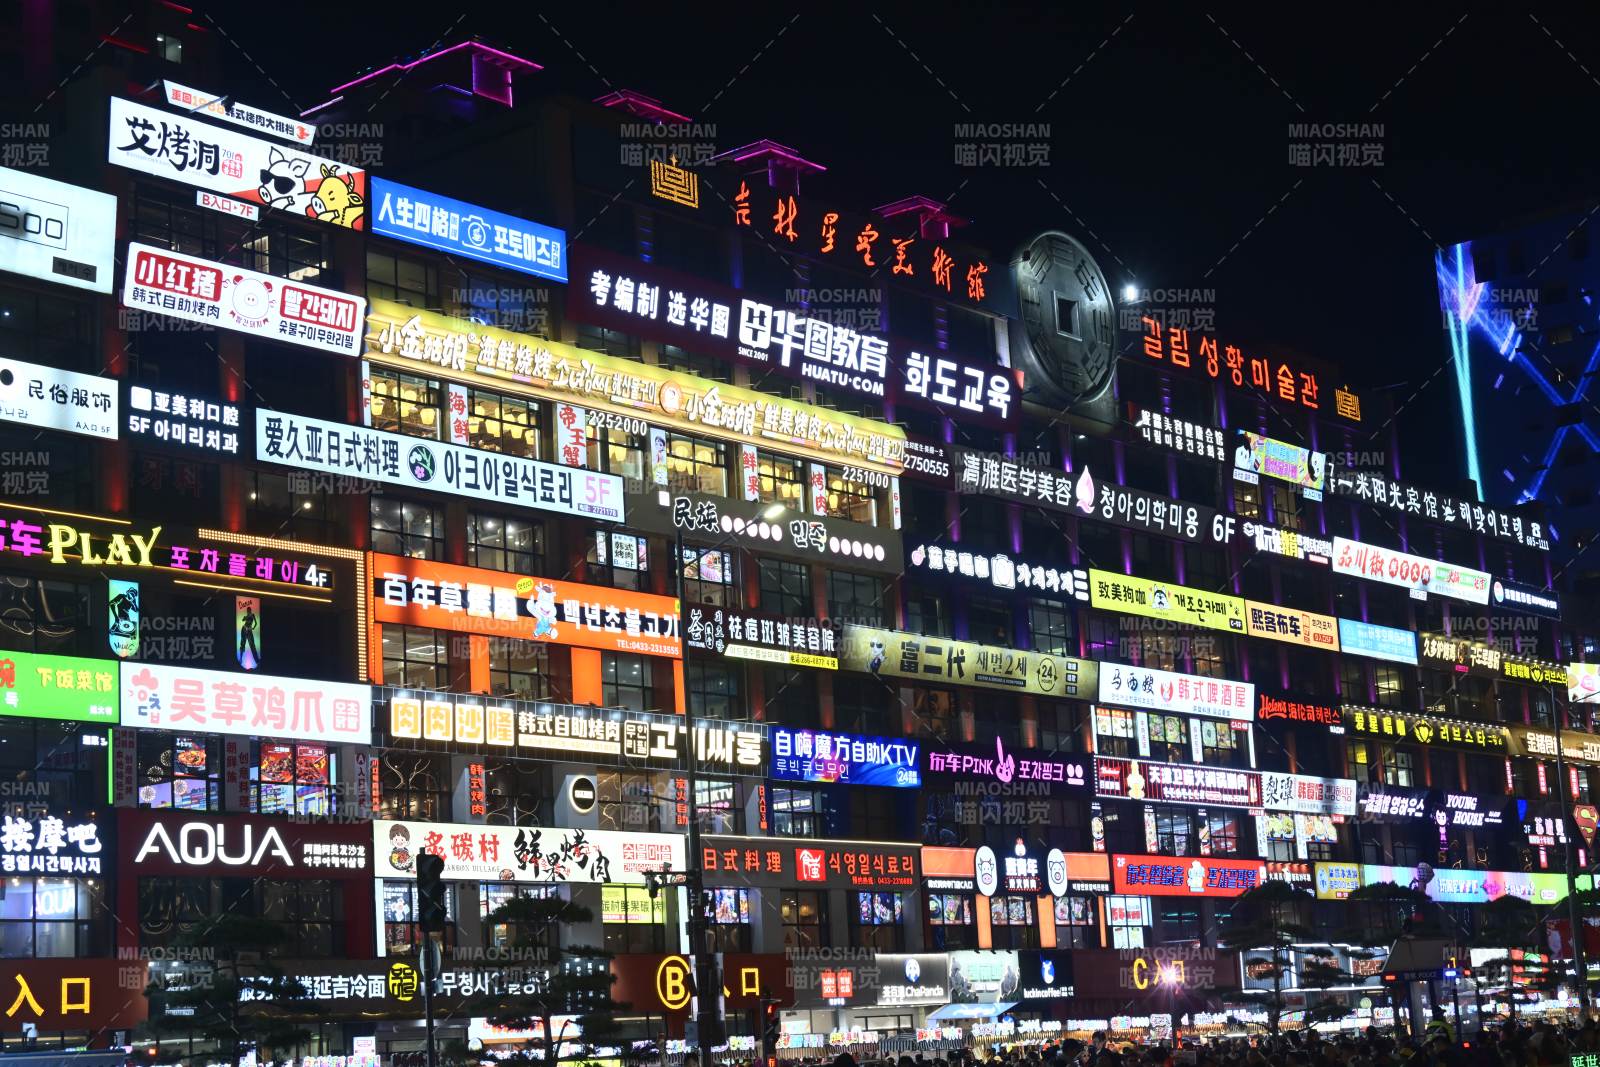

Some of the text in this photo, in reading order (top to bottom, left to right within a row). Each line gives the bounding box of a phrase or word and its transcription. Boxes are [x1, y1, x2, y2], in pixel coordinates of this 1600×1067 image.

[117, 116, 220, 176] 艾烤洞
[202, 194, 254, 217] B入口 7F
[378, 193, 449, 238] 人生四格
[494, 225, 551, 266] 포토이즈
[138, 257, 217, 300] 小红猪
[132, 286, 221, 319] 韩式自助烤肉
[590, 269, 731, 340] 考编制 选华图
[379, 315, 467, 371] 小金姑娘
[477, 335, 553, 379] 海鲜烧烤
[738, 346, 769, 362] SINCE 2001
[771, 308, 889, 378] 华图教育
[28, 379, 112, 413] 民俗服饰
[905, 351, 1012, 420] 화도교육
[154, 391, 240, 427] 亚美利口腔
[449, 391, 469, 443] 海鲜
[588, 411, 647, 436] 2252000
[685, 386, 756, 436] 小金姑娘
[763, 404, 822, 440] 鲜果烤肉
[129, 417, 239, 453] 5F 아미리치과
[265, 417, 400, 478] 爱久亚日式料理
[559, 405, 586, 466] 帝王蟹
[444, 450, 573, 508] 아크아일식료리
[742, 451, 759, 495] 鲜果
[842, 467, 889, 489] 2251000
[904, 455, 949, 477] 2750555
[962, 454, 1073, 506] 清雅医学美容
[585, 475, 612, 506] 5F
[811, 473, 828, 513] 烤肉
[1337, 473, 1438, 520] 一米阳光宾馆
[674, 496, 720, 533] 民族
[1101, 484, 1199, 538] 청아의학미용
[1212, 514, 1236, 543] 6F
[789, 520, 826, 551] 민족
[47, 524, 162, 567] PLAY
[170, 546, 298, 584] 포차플레이
[305, 564, 327, 587] 4F
[1098, 581, 1146, 605] 致美狗咖
[563, 599, 679, 643] 백년초불고기
[901, 641, 965, 678] 富二代
[1042, 665, 1053, 678] 24
[36, 667, 113, 692] 下饭菜馆
[1178, 678, 1246, 708] 韩式啤酒屋
[170, 678, 326, 734] 吴草鸡爪
[392, 700, 514, 742] 肉肉沙隆
[518, 711, 620, 741] 韩式自助烤肉
[626, 724, 648, 739] 무한
[776, 730, 917, 767] 自嗨魔方 自助KTV
[777, 758, 849, 779] 루빅큐브무인
[1018, 760, 1064, 781] 포차핑크
[470, 764, 486, 815] 韩式烤肉
[1446, 795, 1478, 811] YOUNG
[1453, 811, 1485, 826] HOUSE
[134, 822, 294, 867] AQUA
[703, 848, 782, 873] 日式料理
[1117, 857, 1125, 868] 2F
[829, 852, 913, 875] 식영일식료리
[6, 974, 91, 1017] 入口
[906, 985, 943, 998] ChaPanda
